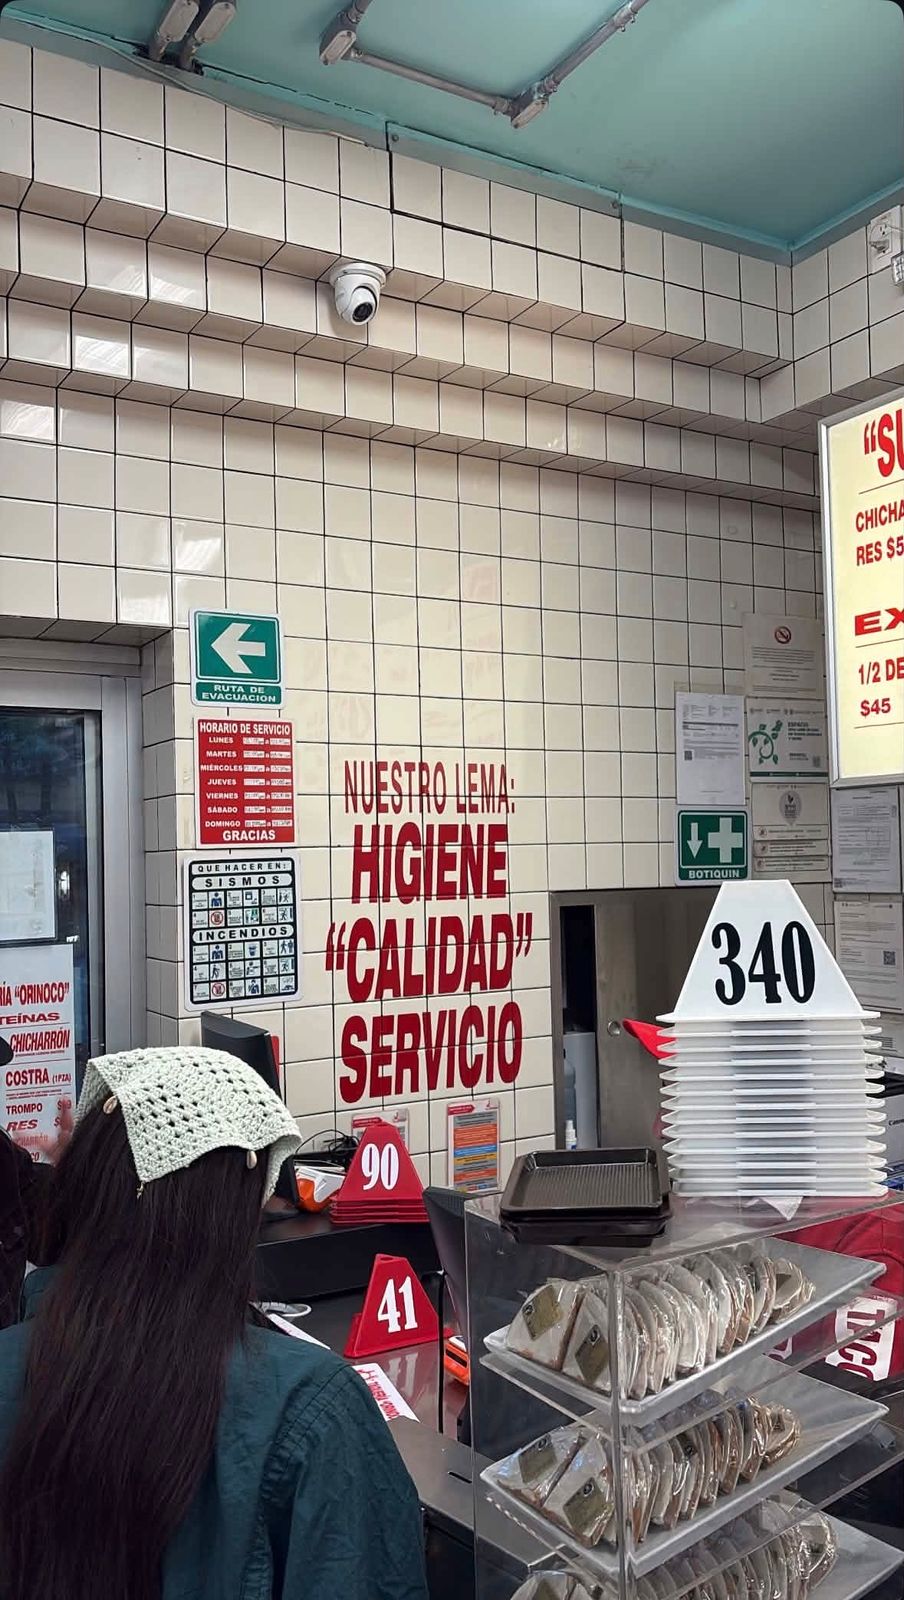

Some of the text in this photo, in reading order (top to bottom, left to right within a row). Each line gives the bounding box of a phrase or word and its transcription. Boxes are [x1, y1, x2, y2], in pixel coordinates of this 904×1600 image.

[856, 541, 883, 567] RES
[855, 607, 904, 636] EX
[858, 656, 904, 685] 1/2 DE
[214, 684, 265, 694] RUTA DE
[202, 692, 277, 704] EVACUACION
[860, 697, 891, 719] $45
[199, 721, 291, 736] HORARIO DE SERVICIO
[209, 736, 234, 744] LUNES
[206, 750, 237, 758] MARTES
[200, 764, 243, 772] MIÉRCOLES
[207, 778, 237, 786] JUEVES
[345, 760, 515, 815] NUESTRO LEMA:
[206, 792, 239, 800] VIERNES
[205, 820, 241, 828] DOMINGO
[222, 829, 276, 842] GRACIAS
[197, 862, 286, 873] QUE HACER EN:
[351, 821, 508, 904] HIGIENE
[205, 875, 280, 888] SISMOS
[688, 869, 740, 880] BOTIQUIN
[199, 926, 288, 941] INCENDIOS
[325, 912, 533, 1003] “CALIDAD”
[711, 920, 816, 1006] 340
[15, 982, 70, 1005] “ORINOCO”
[10, 1027, 70, 1053] CHICHARRÓN
[339, 1001, 523, 1104] SERVICIO
[6, 1068, 50, 1087] COSTRA
[6, 1103, 43, 1115] TROMPO
[6, 1119, 38, 1132] RES
[361, 1143, 399, 1191] 90
[377, 1275, 418, 1333] 41
